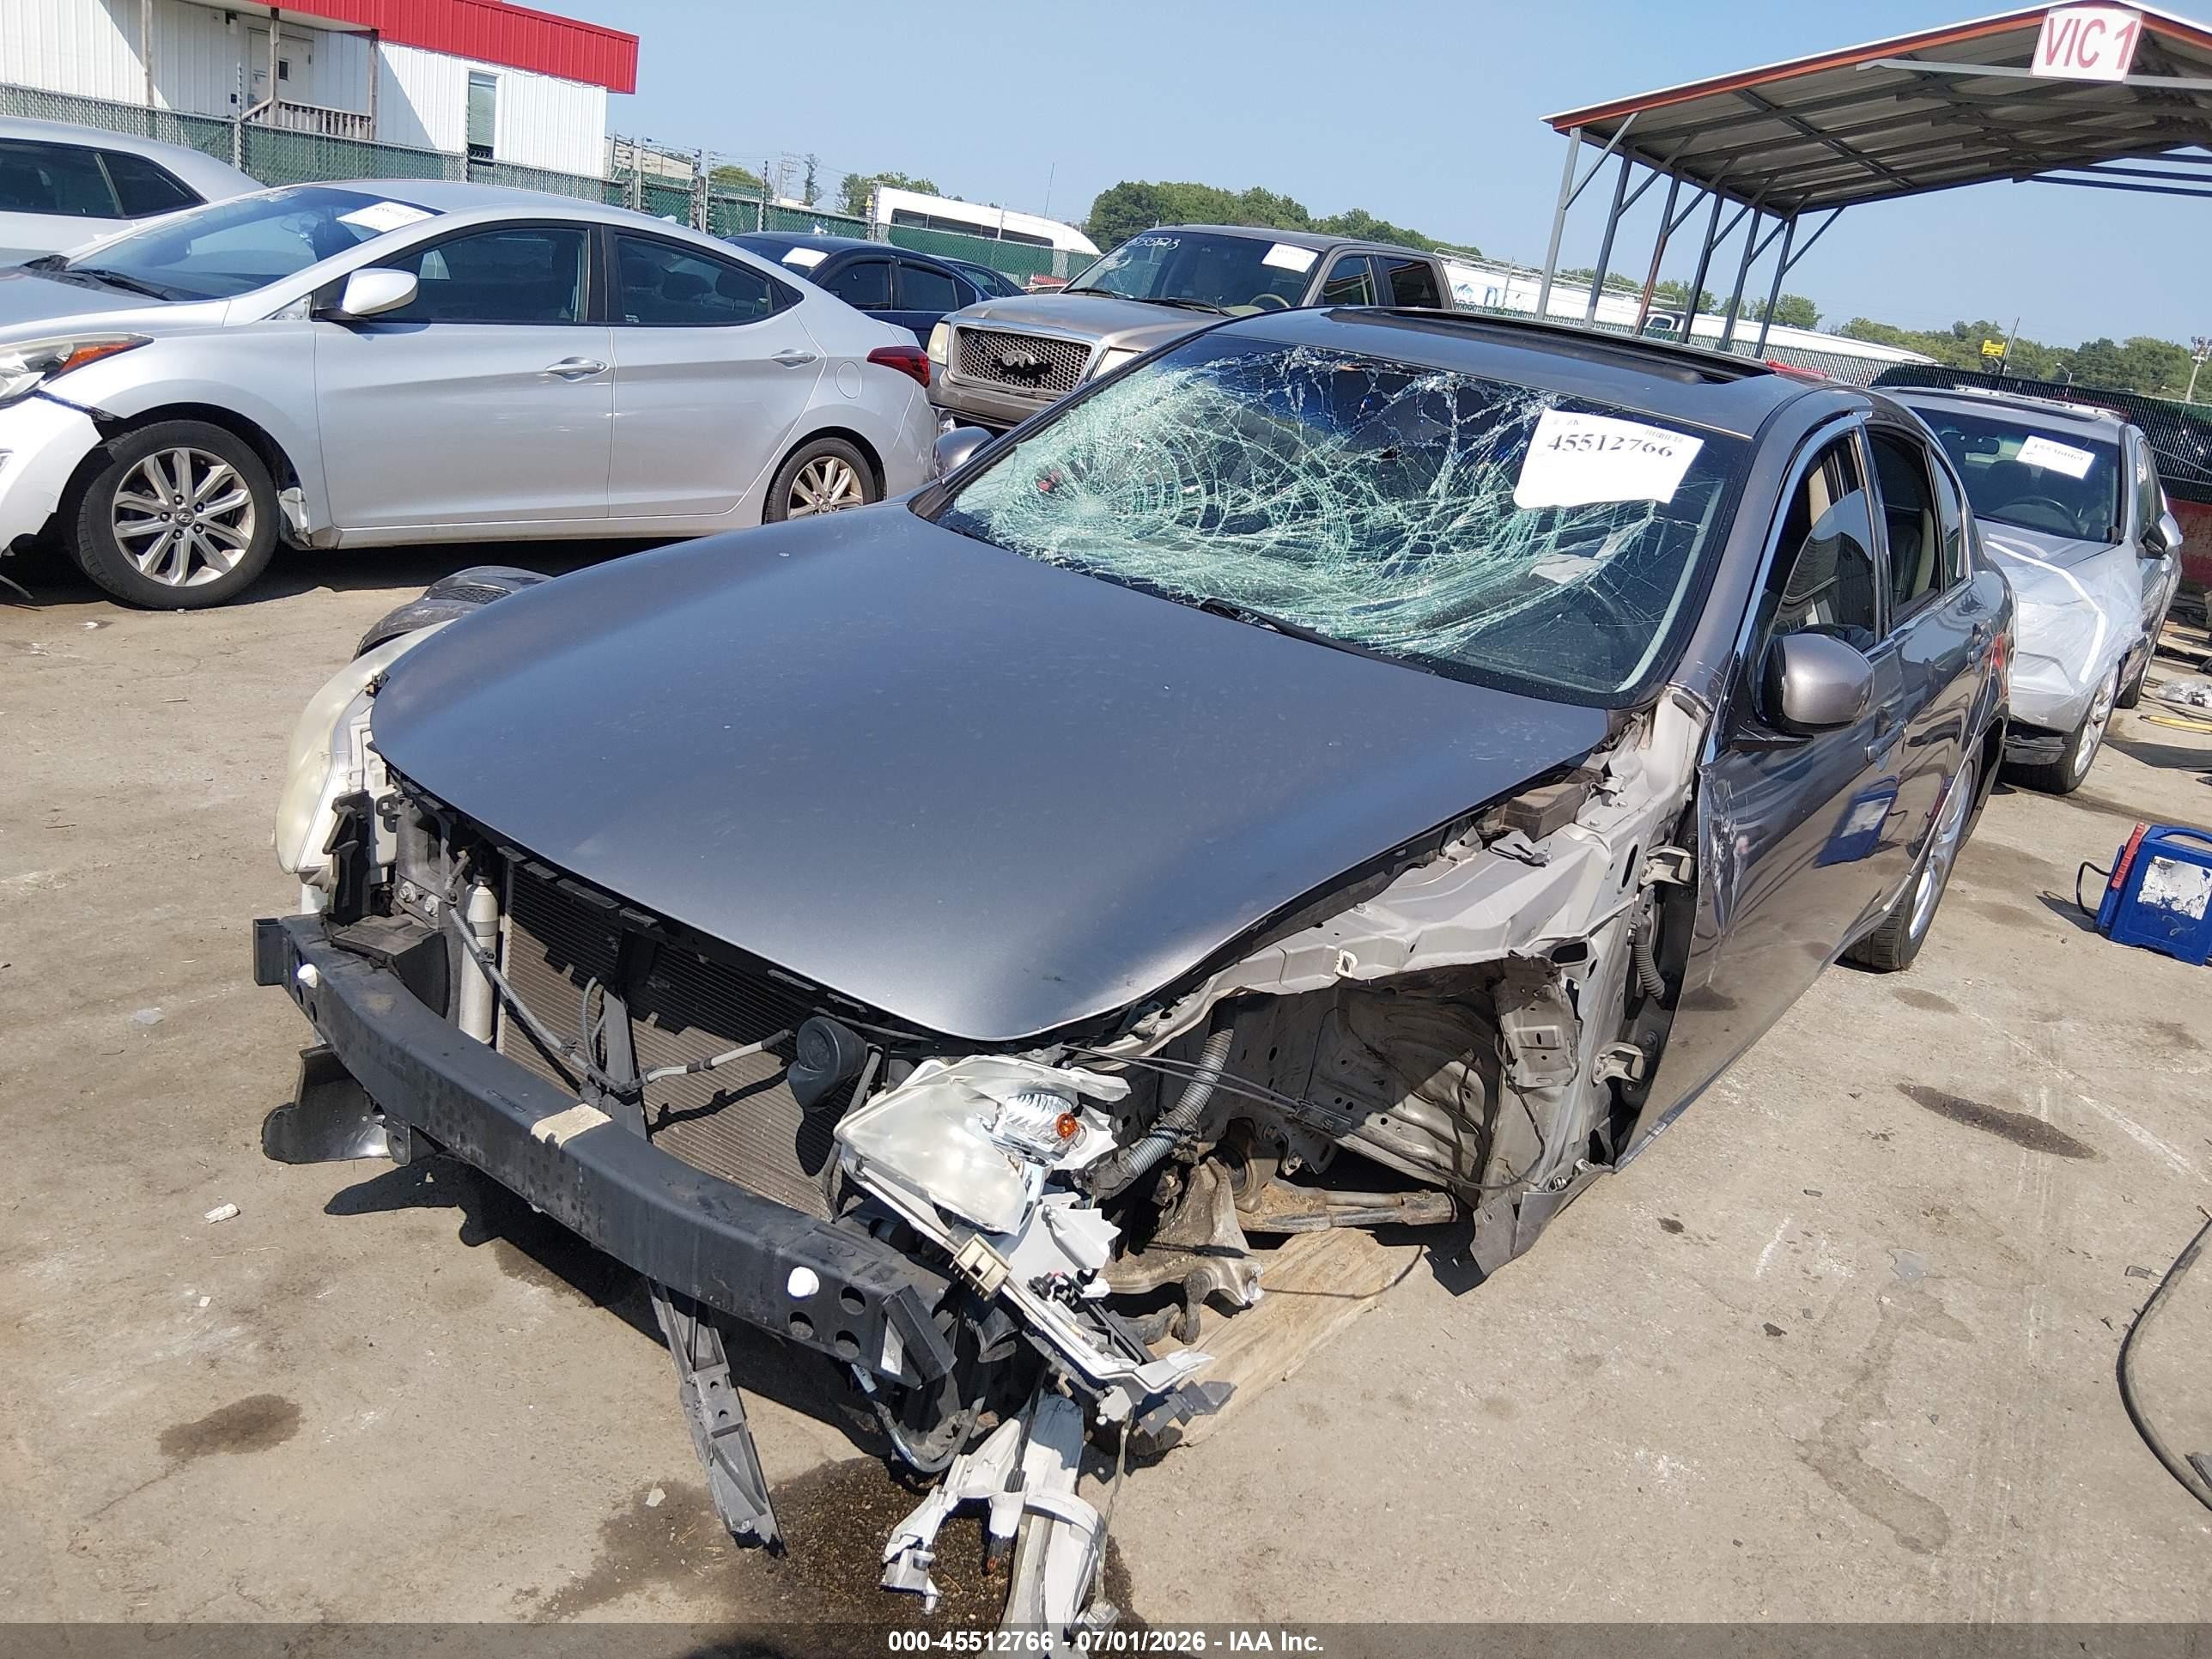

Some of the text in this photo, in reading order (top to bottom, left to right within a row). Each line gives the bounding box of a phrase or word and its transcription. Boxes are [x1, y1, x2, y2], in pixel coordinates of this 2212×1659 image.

[2045, 17, 2137, 70] VIC 1
[1547, 434, 1673, 457] 45512766
